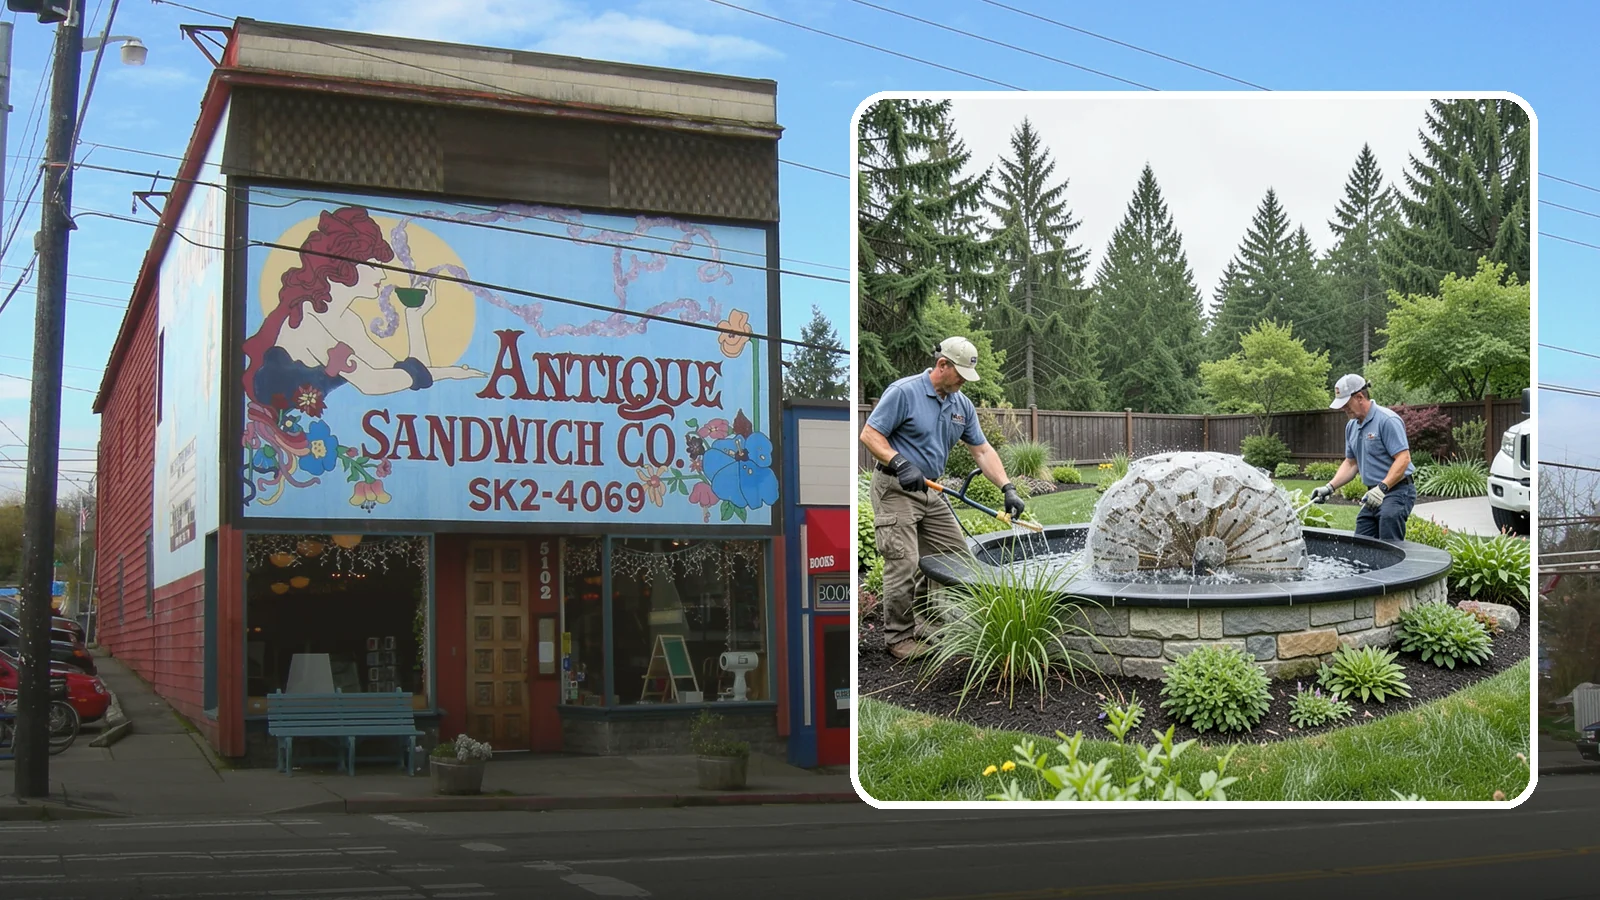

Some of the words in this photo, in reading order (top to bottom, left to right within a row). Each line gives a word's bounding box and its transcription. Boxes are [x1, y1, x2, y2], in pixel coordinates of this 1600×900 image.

[476, 328, 722, 420] ANTIQUE
[361, 409, 605, 466] SANDWICH
[617, 423, 685, 468] CO.
[468, 477, 646, 513] SK2-4069
[540, 541, 551, 599] 5102
[810, 555, 834, 568] BOOKS
